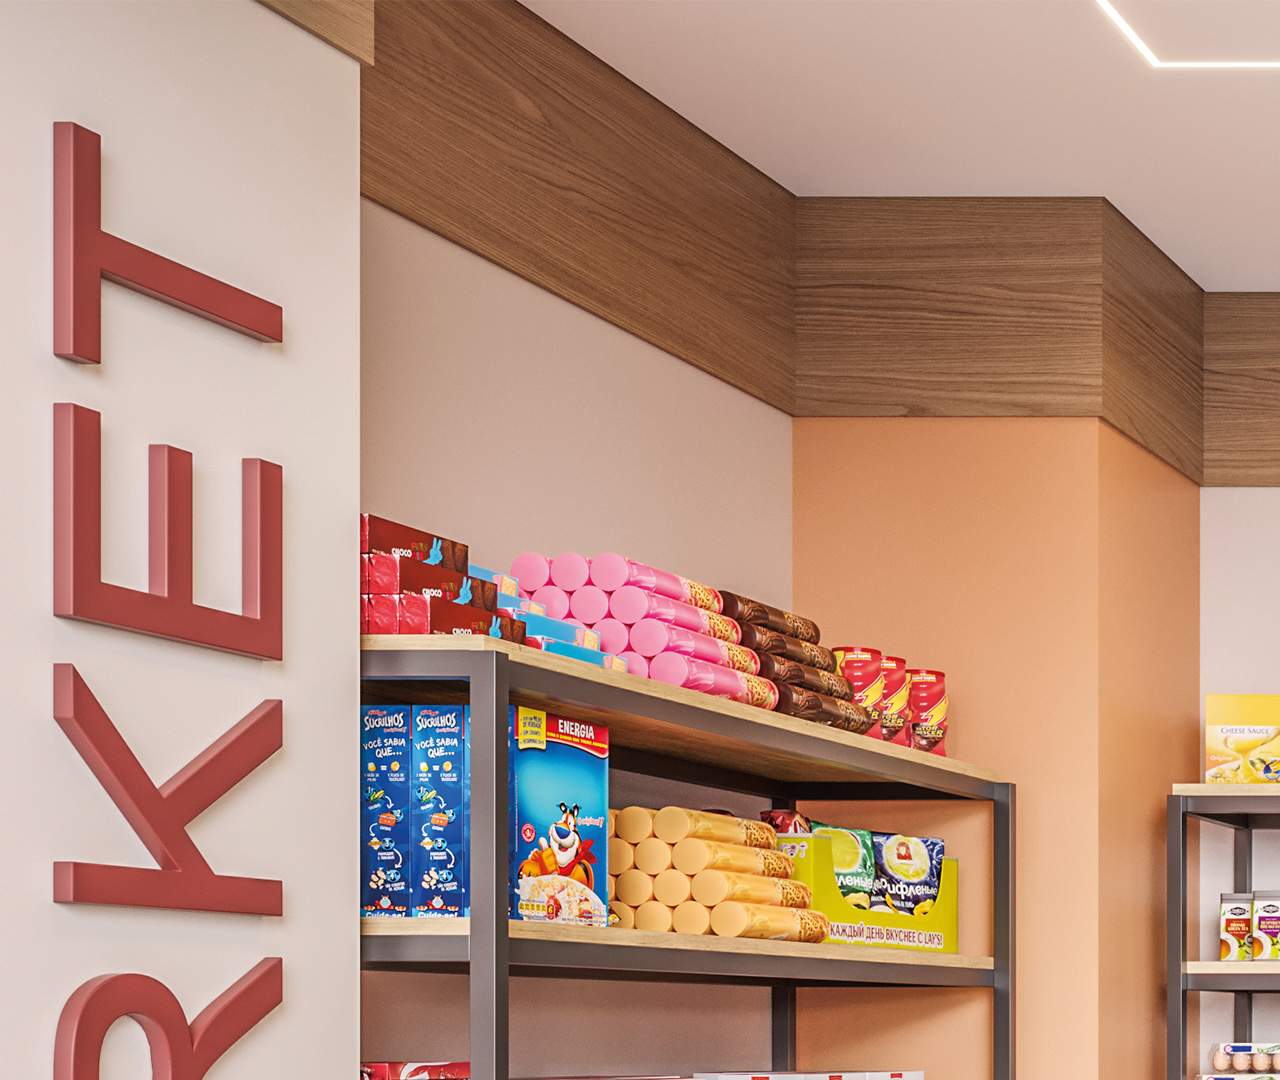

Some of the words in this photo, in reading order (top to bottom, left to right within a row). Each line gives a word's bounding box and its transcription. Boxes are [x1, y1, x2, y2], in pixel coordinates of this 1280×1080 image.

[392, 548, 412, 557] CHOCO
[422, 589, 442, 598] CHOCO
[558, 720, 594, 739] ENERGIA
[363, 737, 381, 749] VOCÊ
[383, 739, 406, 747] SABIA
[415, 737, 434, 749] VOCÊ
[436, 739, 458, 747] SABIA
[830, 923, 865, 938] КАЖДЫЙ
[866, 927, 884, 940] ДЕНЬ
[886, 930, 915, 943] ВКУСНЕЕ
